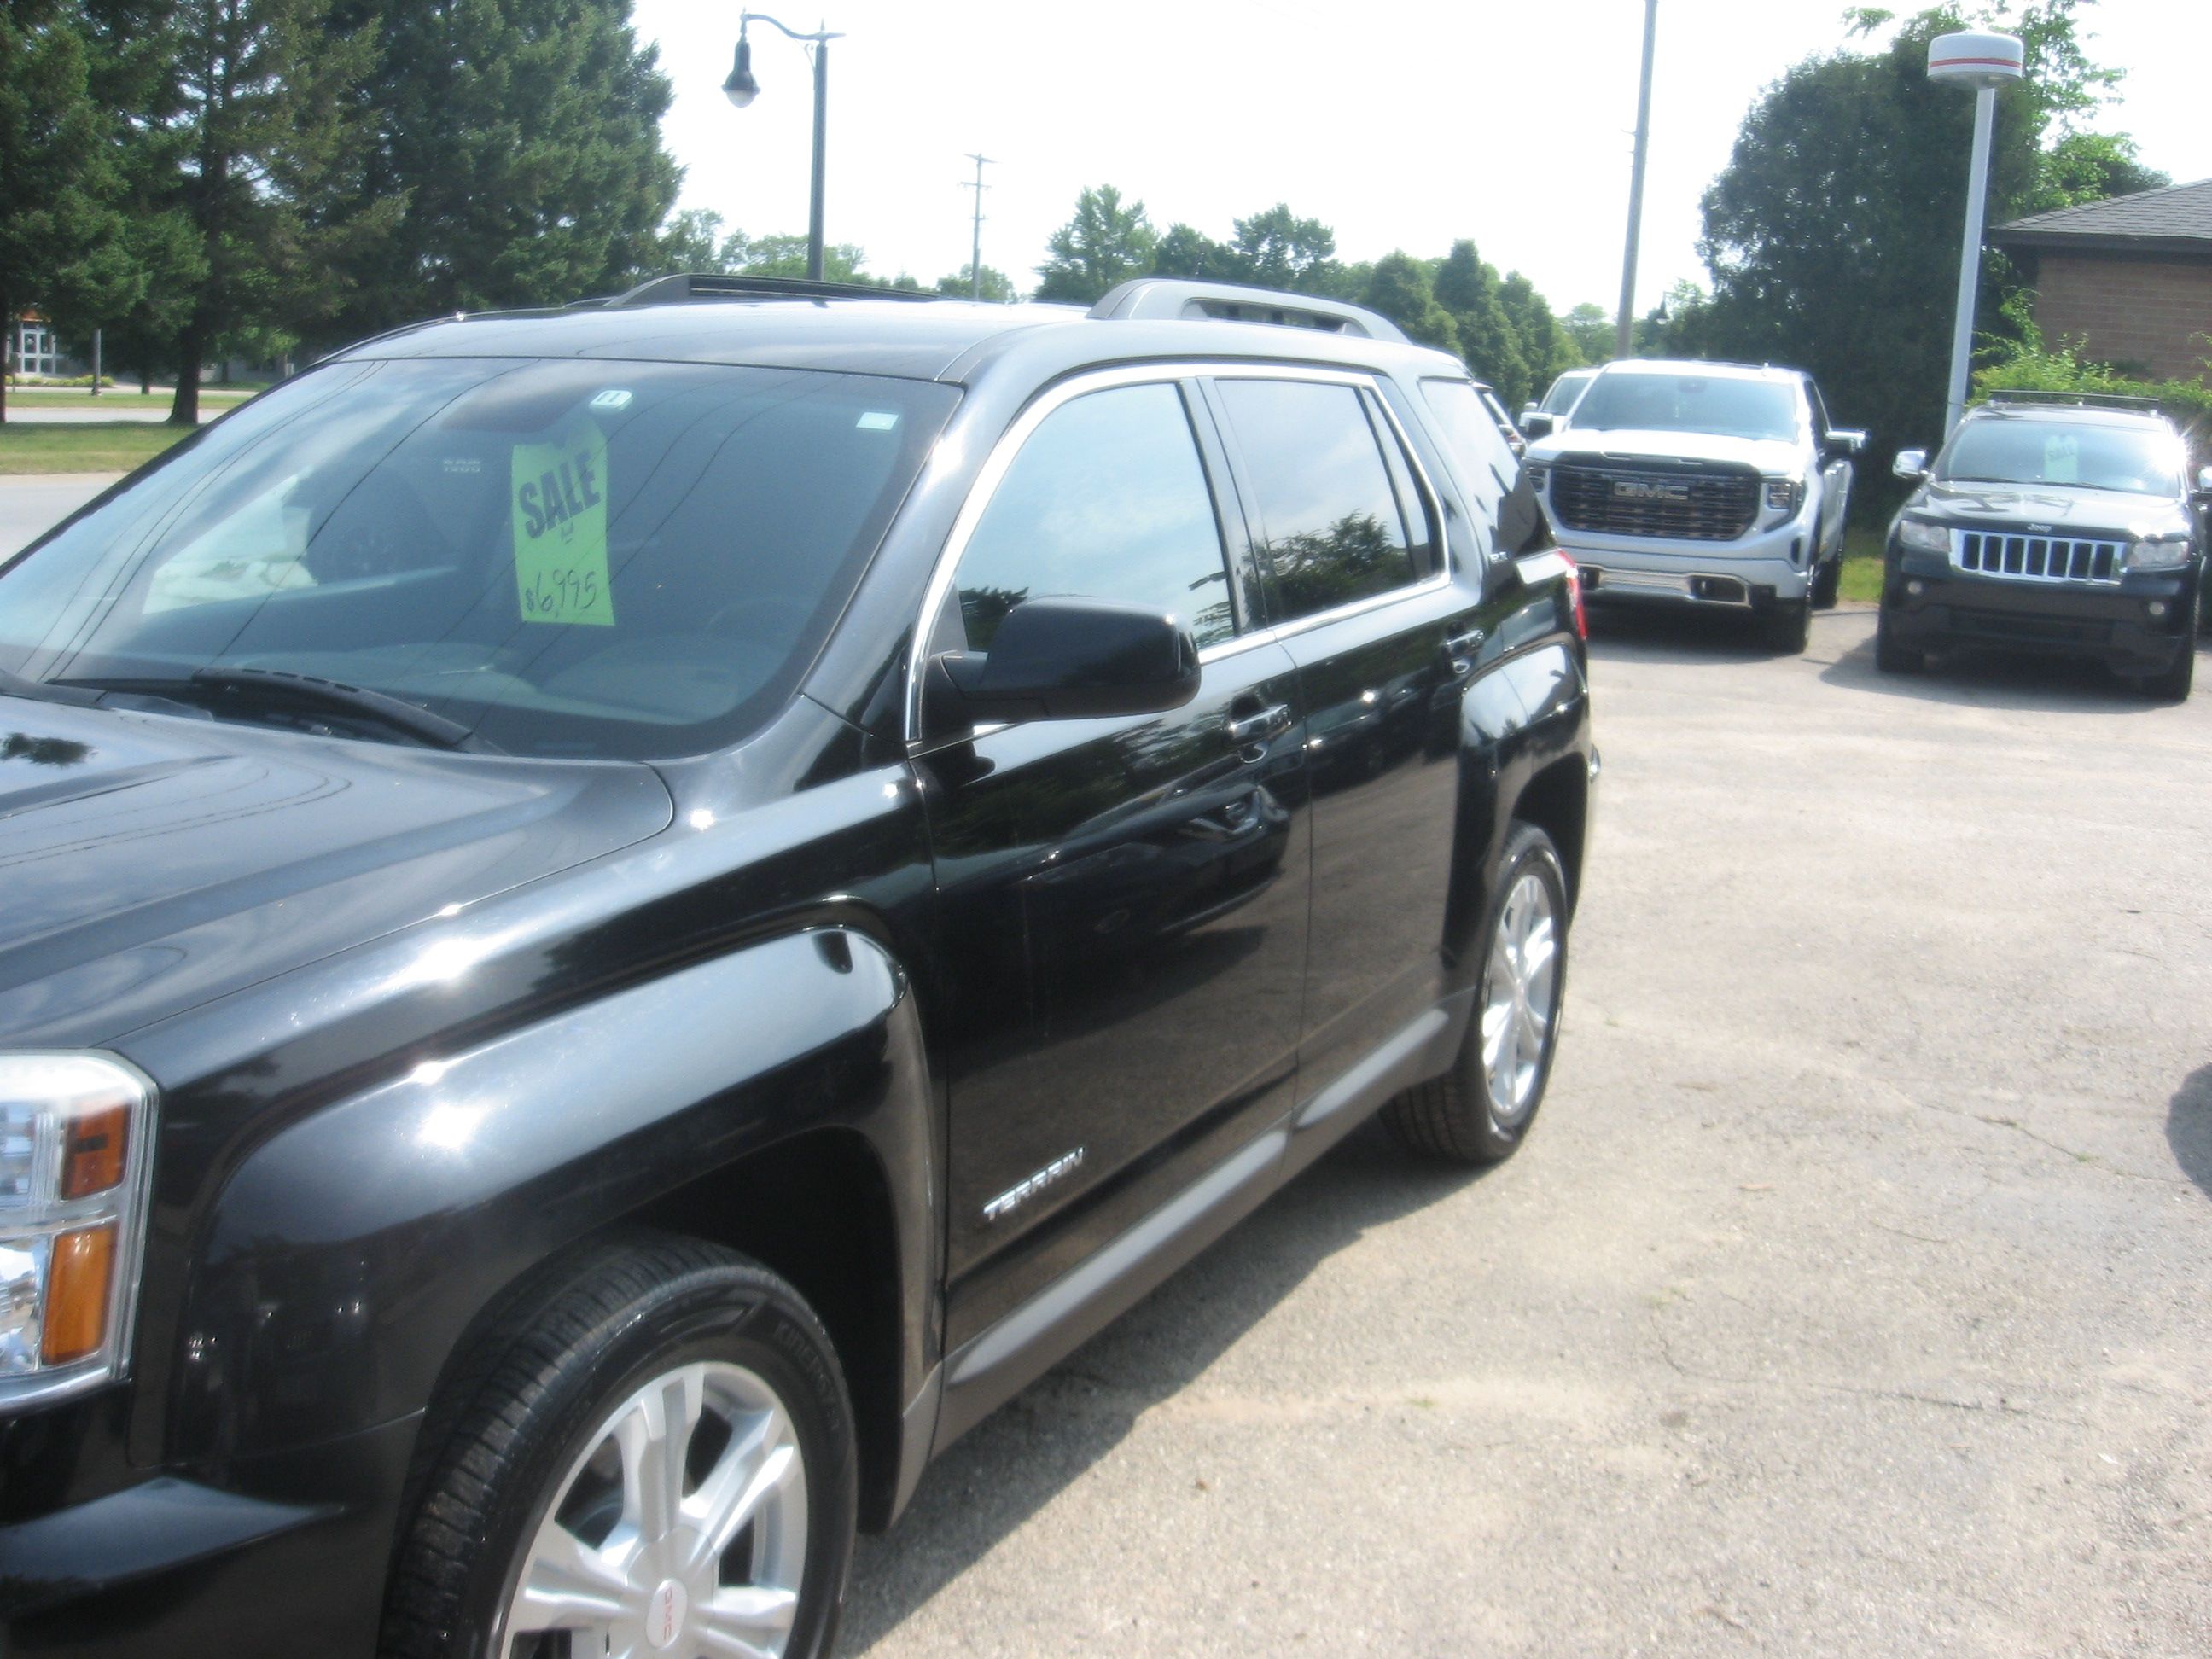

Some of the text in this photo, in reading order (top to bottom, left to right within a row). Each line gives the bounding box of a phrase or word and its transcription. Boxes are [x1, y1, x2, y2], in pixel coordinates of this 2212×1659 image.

[519, 451, 601, 539] SALE
[1615, 481, 1689, 500] GMC
[983, 1146, 1084, 1221] TERRAIN
[663, 1586, 672, 1640] GMC
